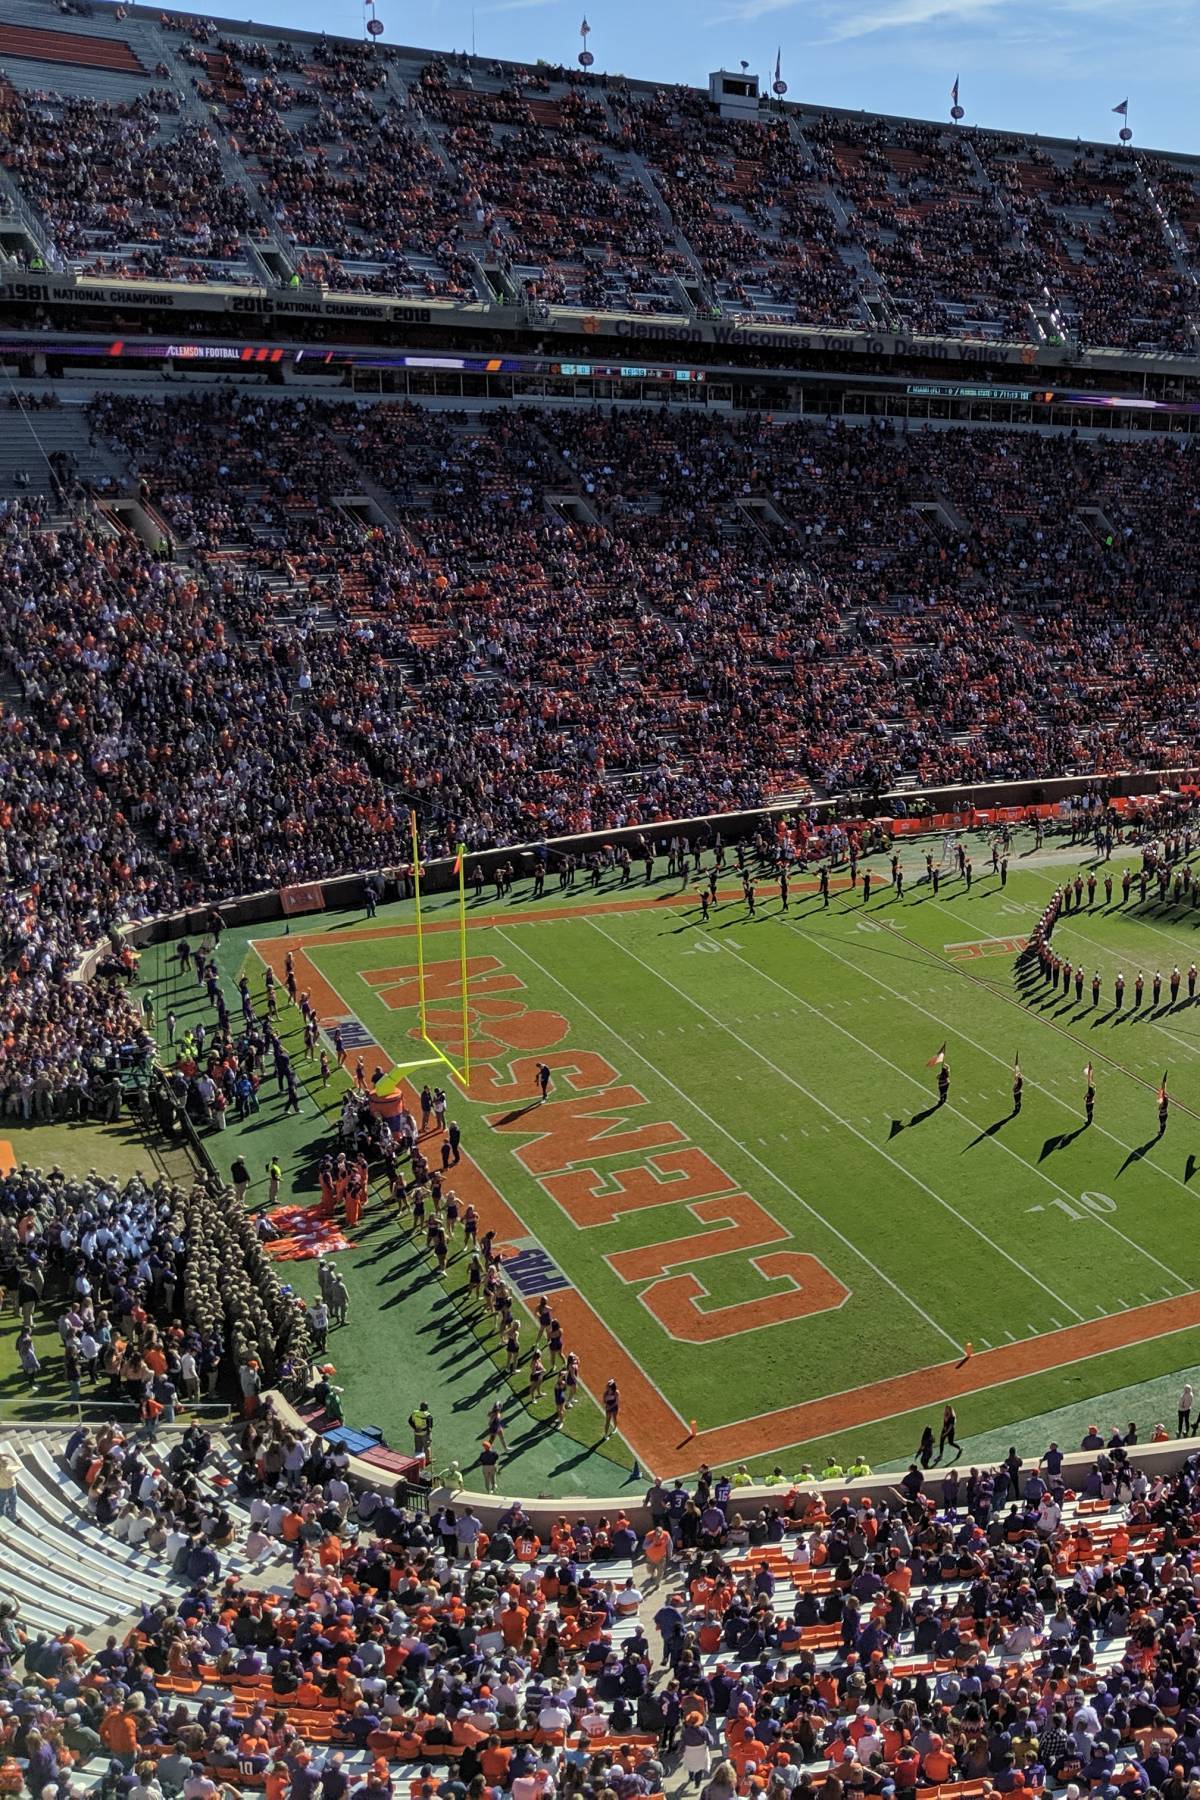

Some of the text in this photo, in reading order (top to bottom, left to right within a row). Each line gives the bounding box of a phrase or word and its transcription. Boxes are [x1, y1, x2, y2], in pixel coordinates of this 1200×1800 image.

[8, 283, 174, 306] 1981 NATIONAL CHAMPIONS
[233, 297, 383, 318] 2016 NATIONAL CHAMPIONS
[393, 308, 431, 322] 2018
[170, 346, 240, 359] CLEMSON FOOTBALL
[615, 320, 1009, 364] Clemson Welcomes You To Death Valley
[1049, 1191, 1118, 1221] 10
[501, 1248, 571, 1296] IPTAY
